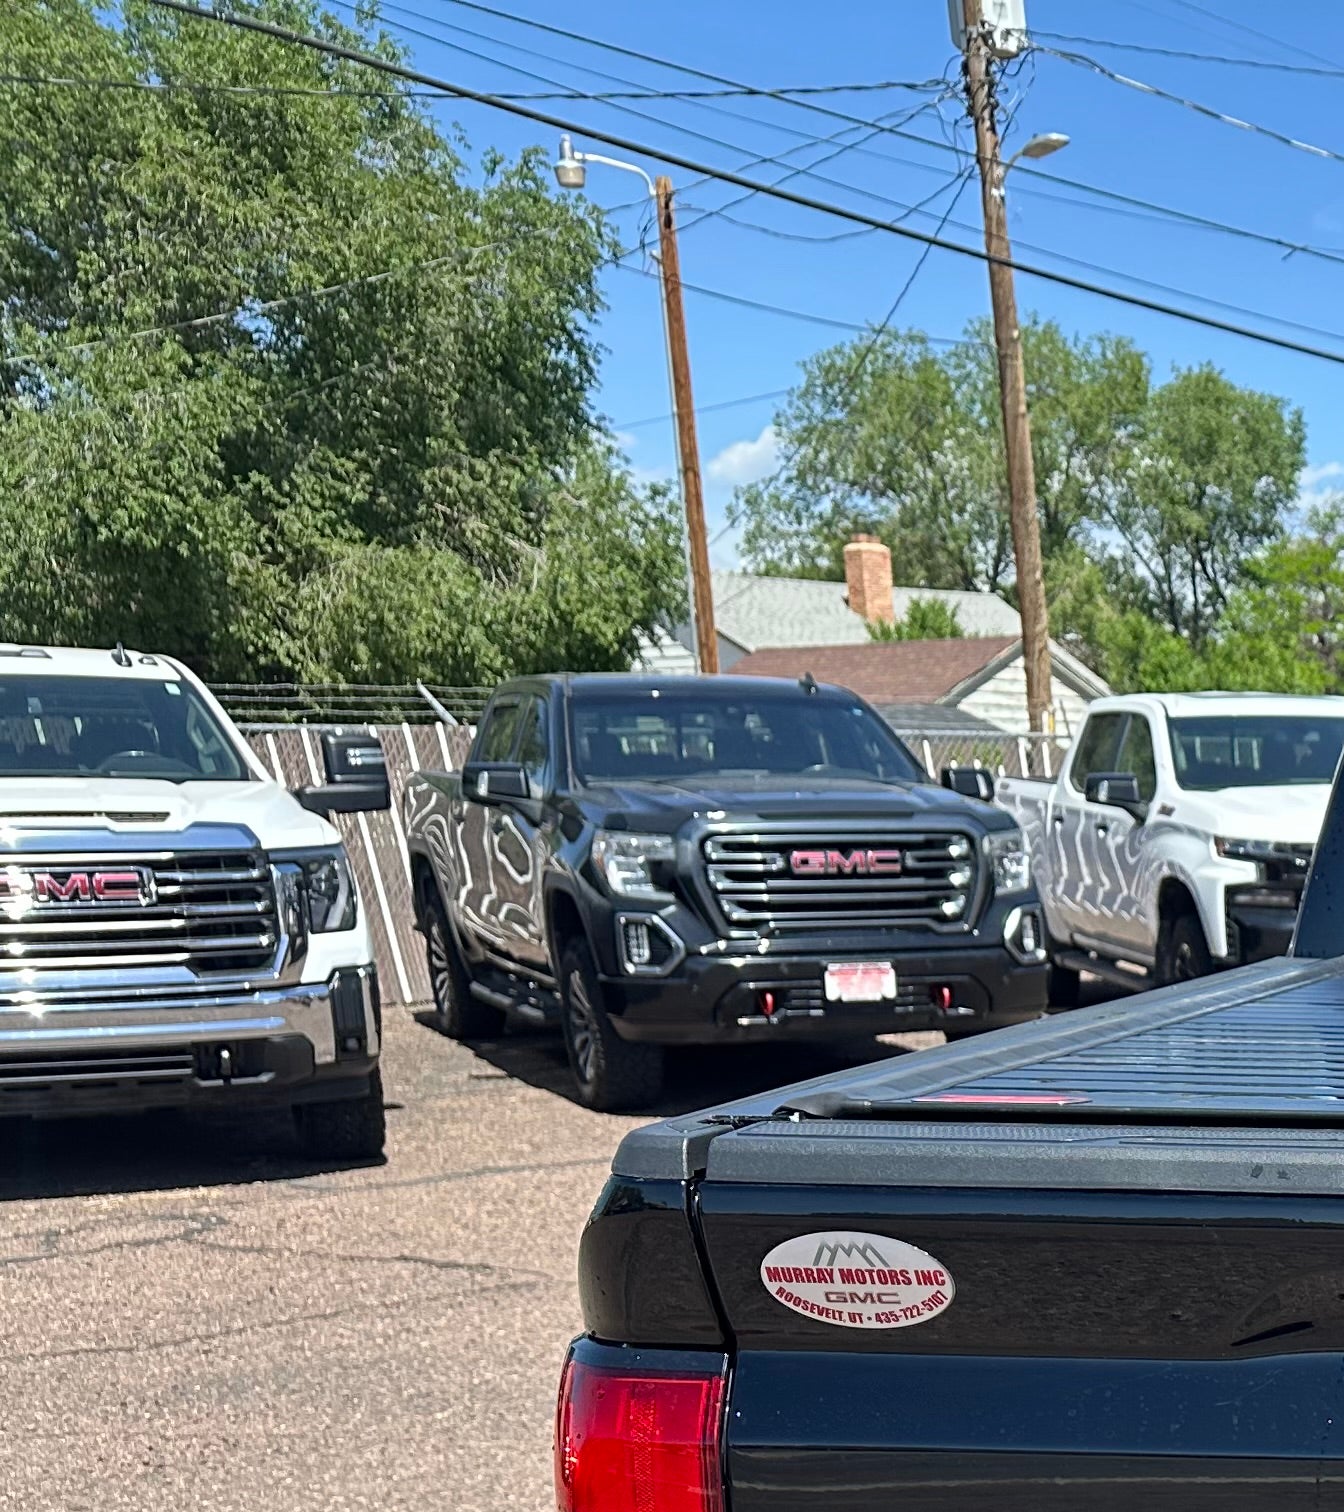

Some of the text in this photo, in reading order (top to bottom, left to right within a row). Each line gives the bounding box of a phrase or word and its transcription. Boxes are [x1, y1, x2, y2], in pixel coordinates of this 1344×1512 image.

[790, 850, 902, 875] GMC
[765, 1266, 946, 1287] MURRAY MOTORS INC
[824, 1290, 902, 1305] GMC
[848, 1311, 864, 1325] UT
[875, 1289, 948, 1325] 435-722-5107
